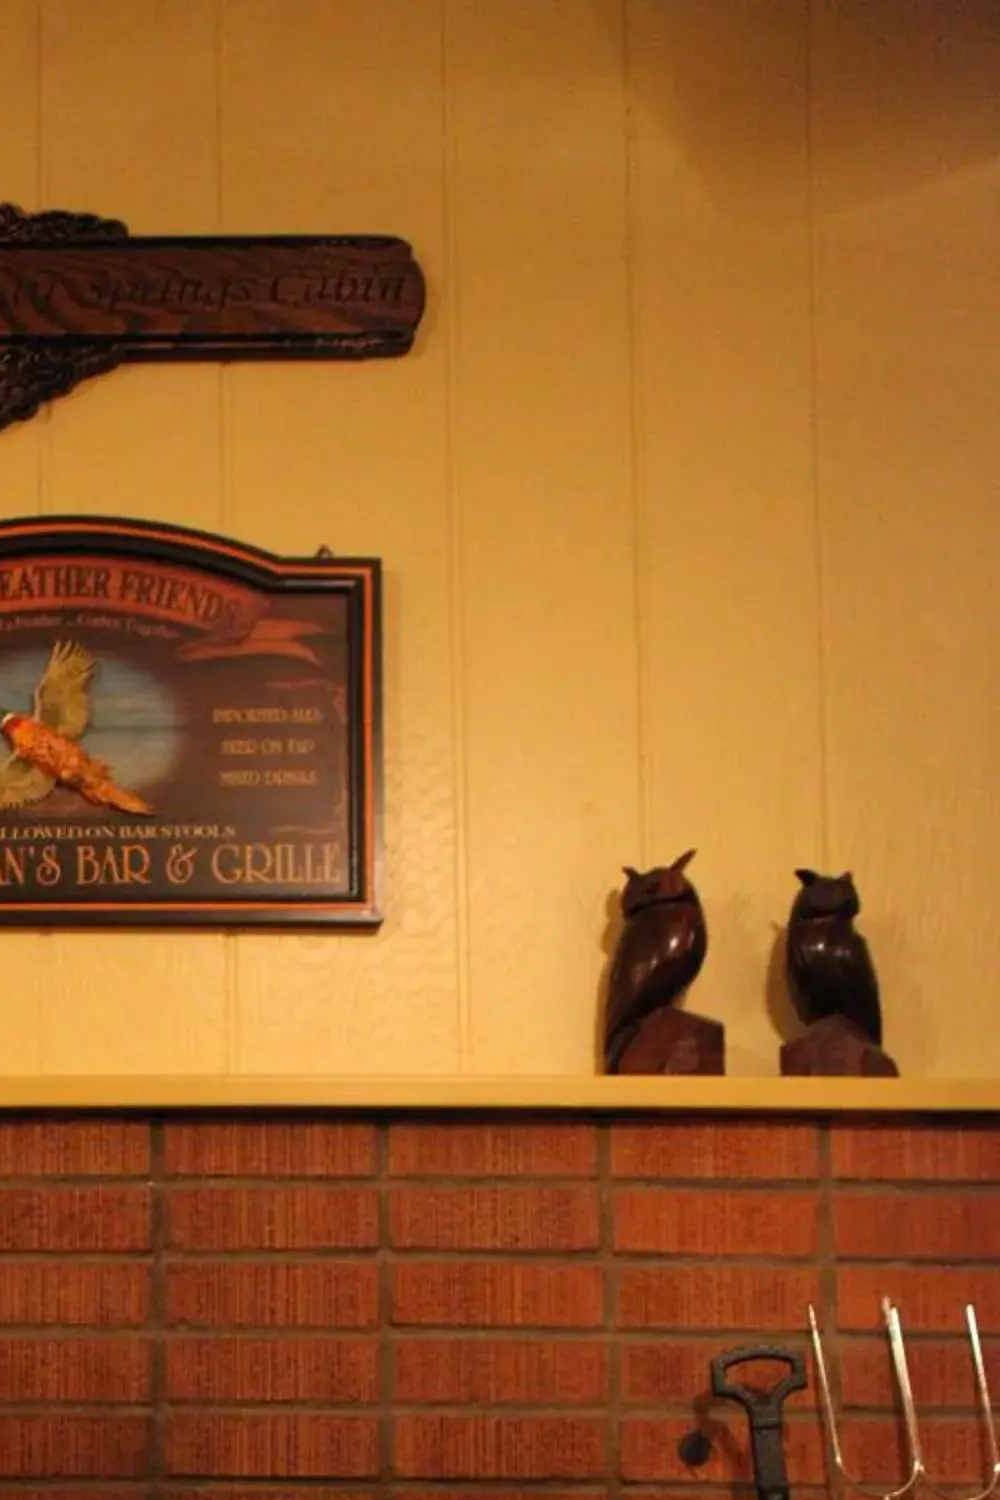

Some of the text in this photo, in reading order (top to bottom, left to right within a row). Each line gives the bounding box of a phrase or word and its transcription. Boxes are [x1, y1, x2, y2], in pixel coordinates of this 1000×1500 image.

[120, 570, 241, 630] FRIENDS
[84, 824, 116, 841] ON
[76, 843, 152, 886] BAR
[165, 842, 199, 885] &
[210, 842, 342, 885] GRILLE
